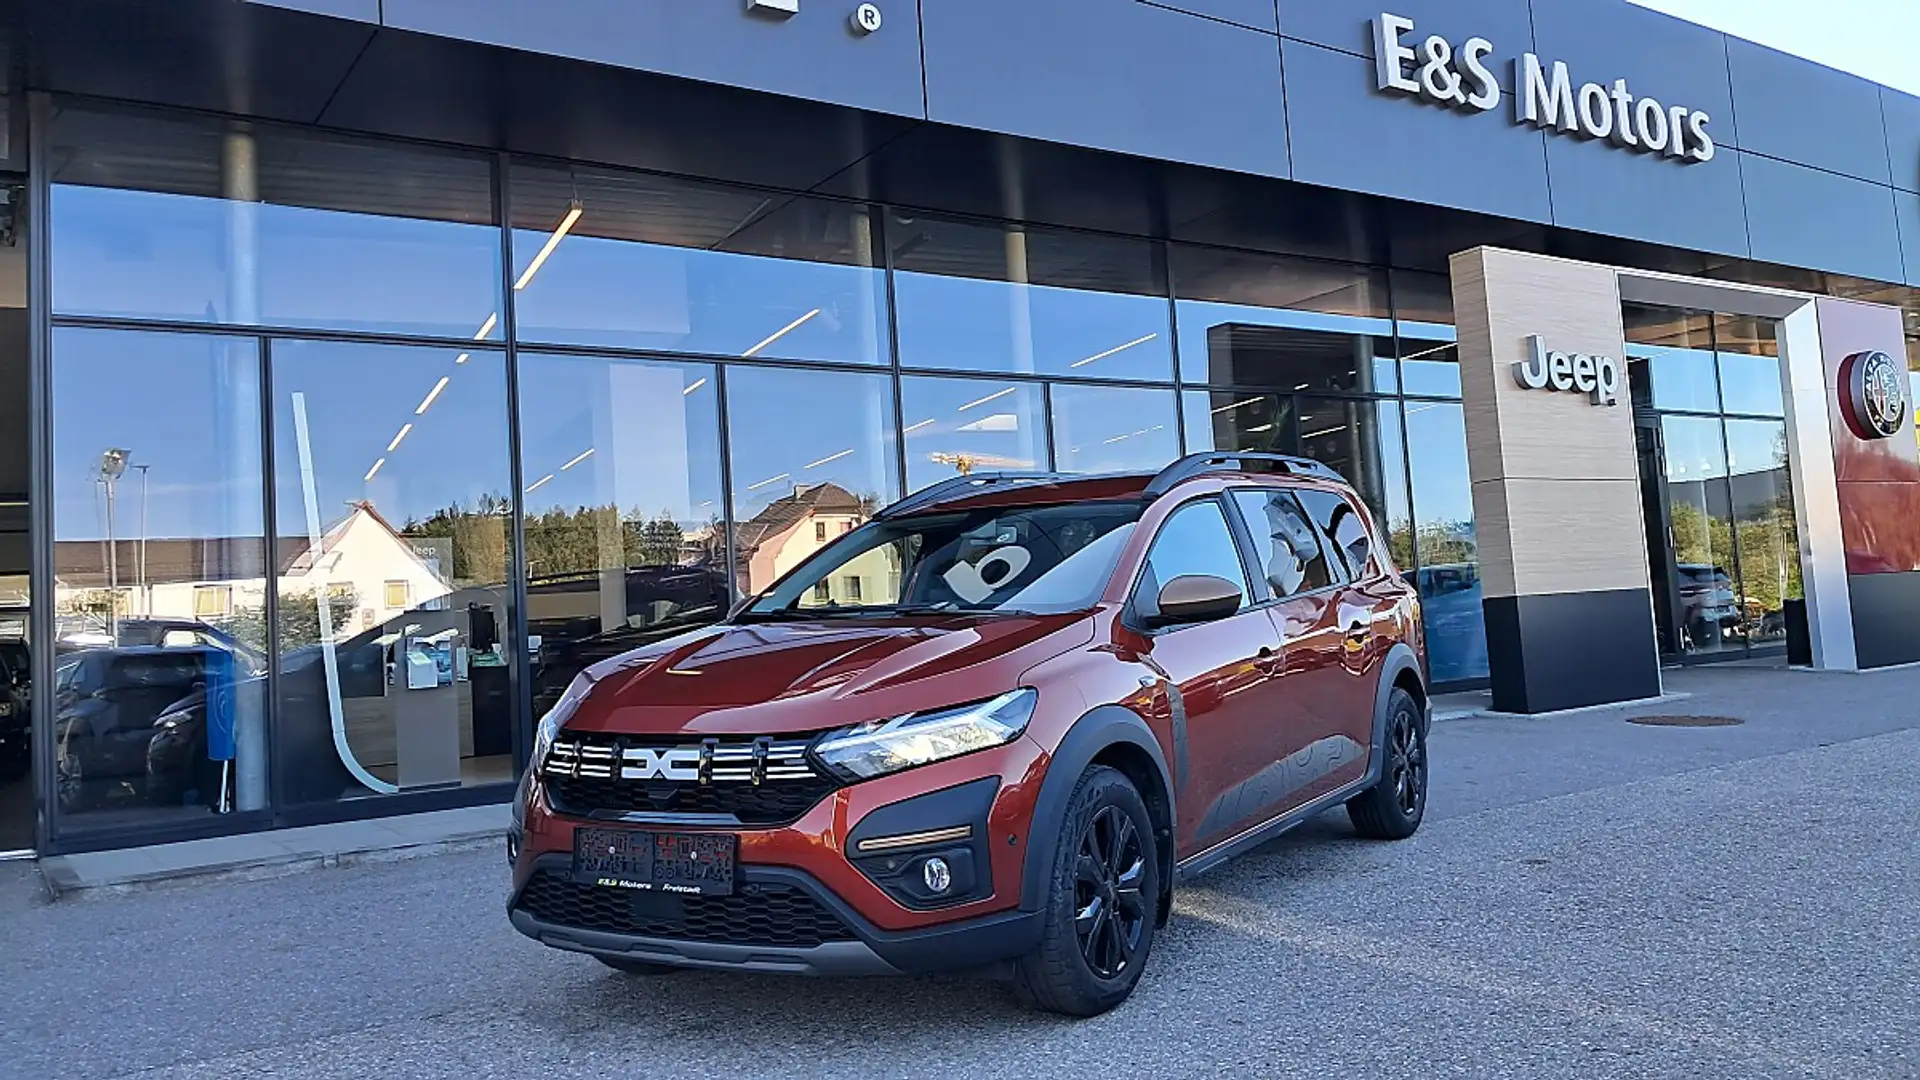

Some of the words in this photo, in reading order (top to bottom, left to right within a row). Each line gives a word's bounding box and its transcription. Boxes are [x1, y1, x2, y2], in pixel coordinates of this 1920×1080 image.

[1373, 12, 1500, 110] E&S
[1513, 52, 1715, 162] Motors
[1511, 334, 1619, 405] Jeep
